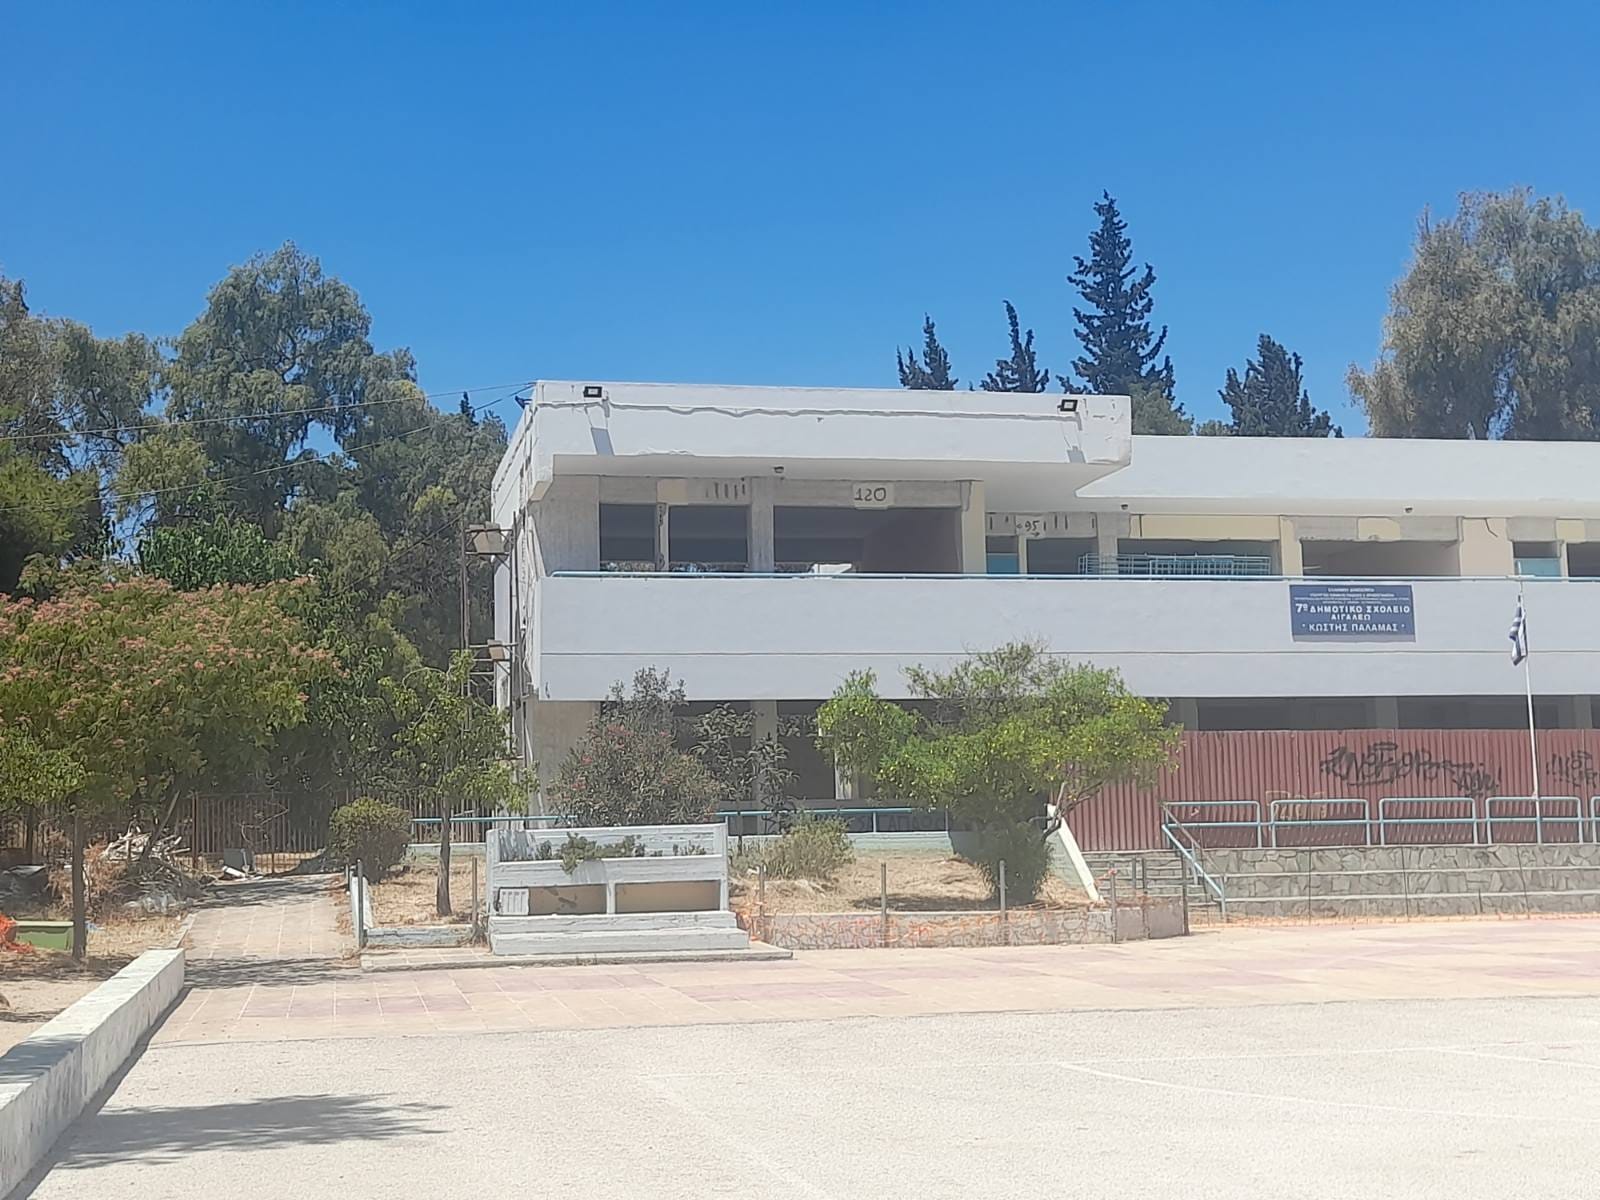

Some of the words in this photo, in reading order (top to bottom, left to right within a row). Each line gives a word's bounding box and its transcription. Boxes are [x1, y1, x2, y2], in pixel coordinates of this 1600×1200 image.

[853, 487, 887, 502] 120
[1309, 605, 1362, 613] ΔΗΜΟΤΙΚΟ
[1366, 605, 1411, 613] ΣΧΟΛΕΙΟ
[1331, 613, 1371, 621] ΑΙΓΑΛΕΩ
[1309, 623, 1348, 632] ΚΩΣΤΗΣ
[1351, 623, 1398, 632] ΠΑΛΑΜΑΣ
